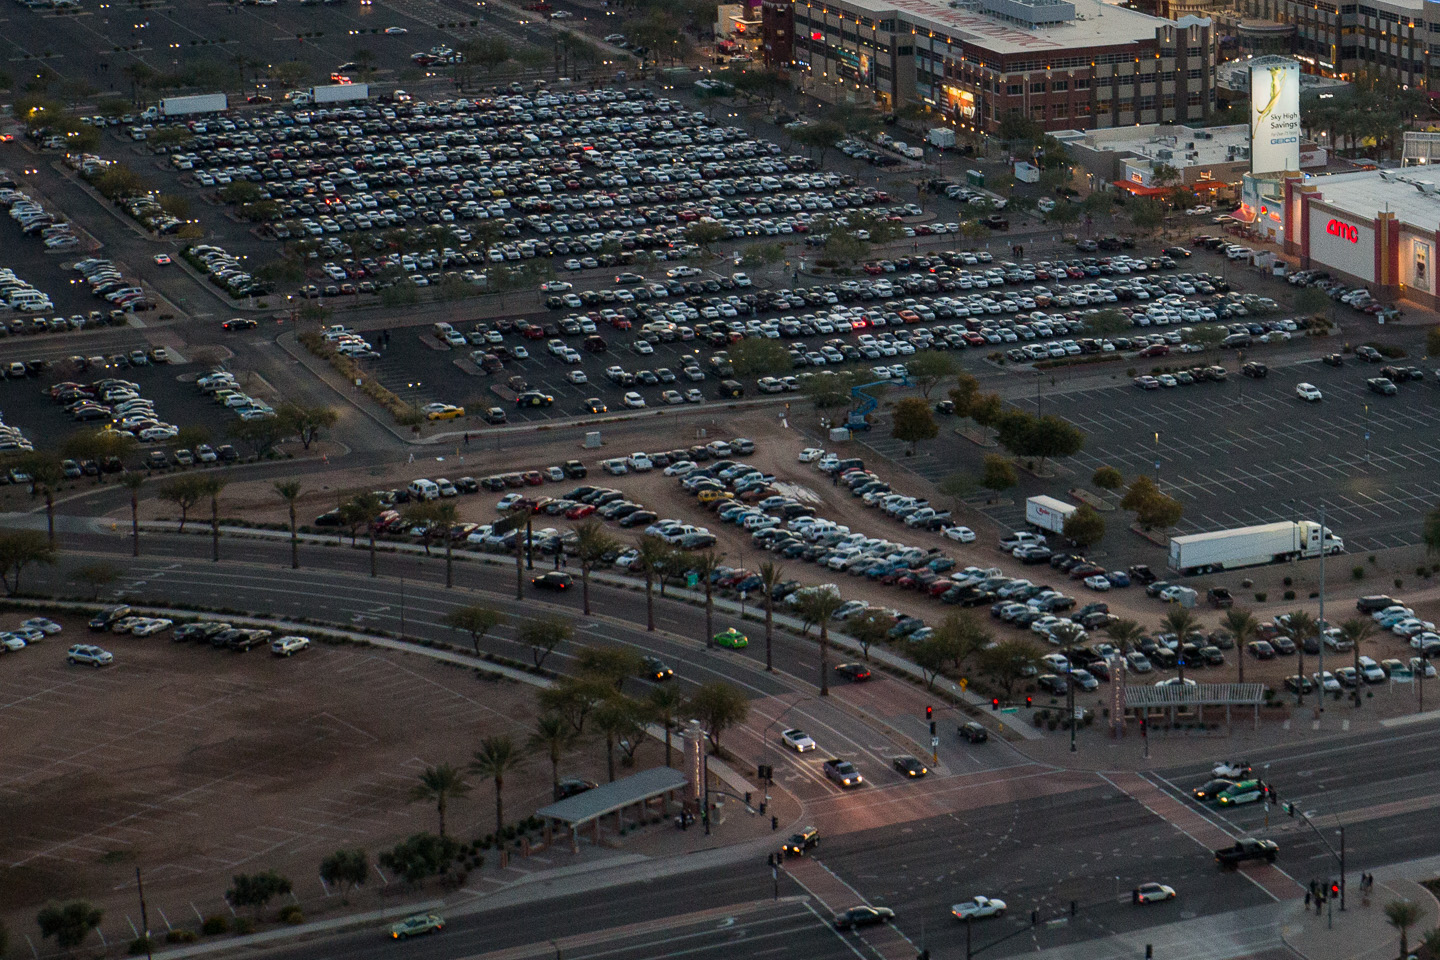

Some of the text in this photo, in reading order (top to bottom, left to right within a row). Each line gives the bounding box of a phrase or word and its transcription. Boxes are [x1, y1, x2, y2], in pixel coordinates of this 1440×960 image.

[1283, 112, 1298, 121] High
[1270, 121, 1298, 130] Savings
[1270, 137, 1297, 145] GEICO
[1326, 218, 1359, 244] amc
